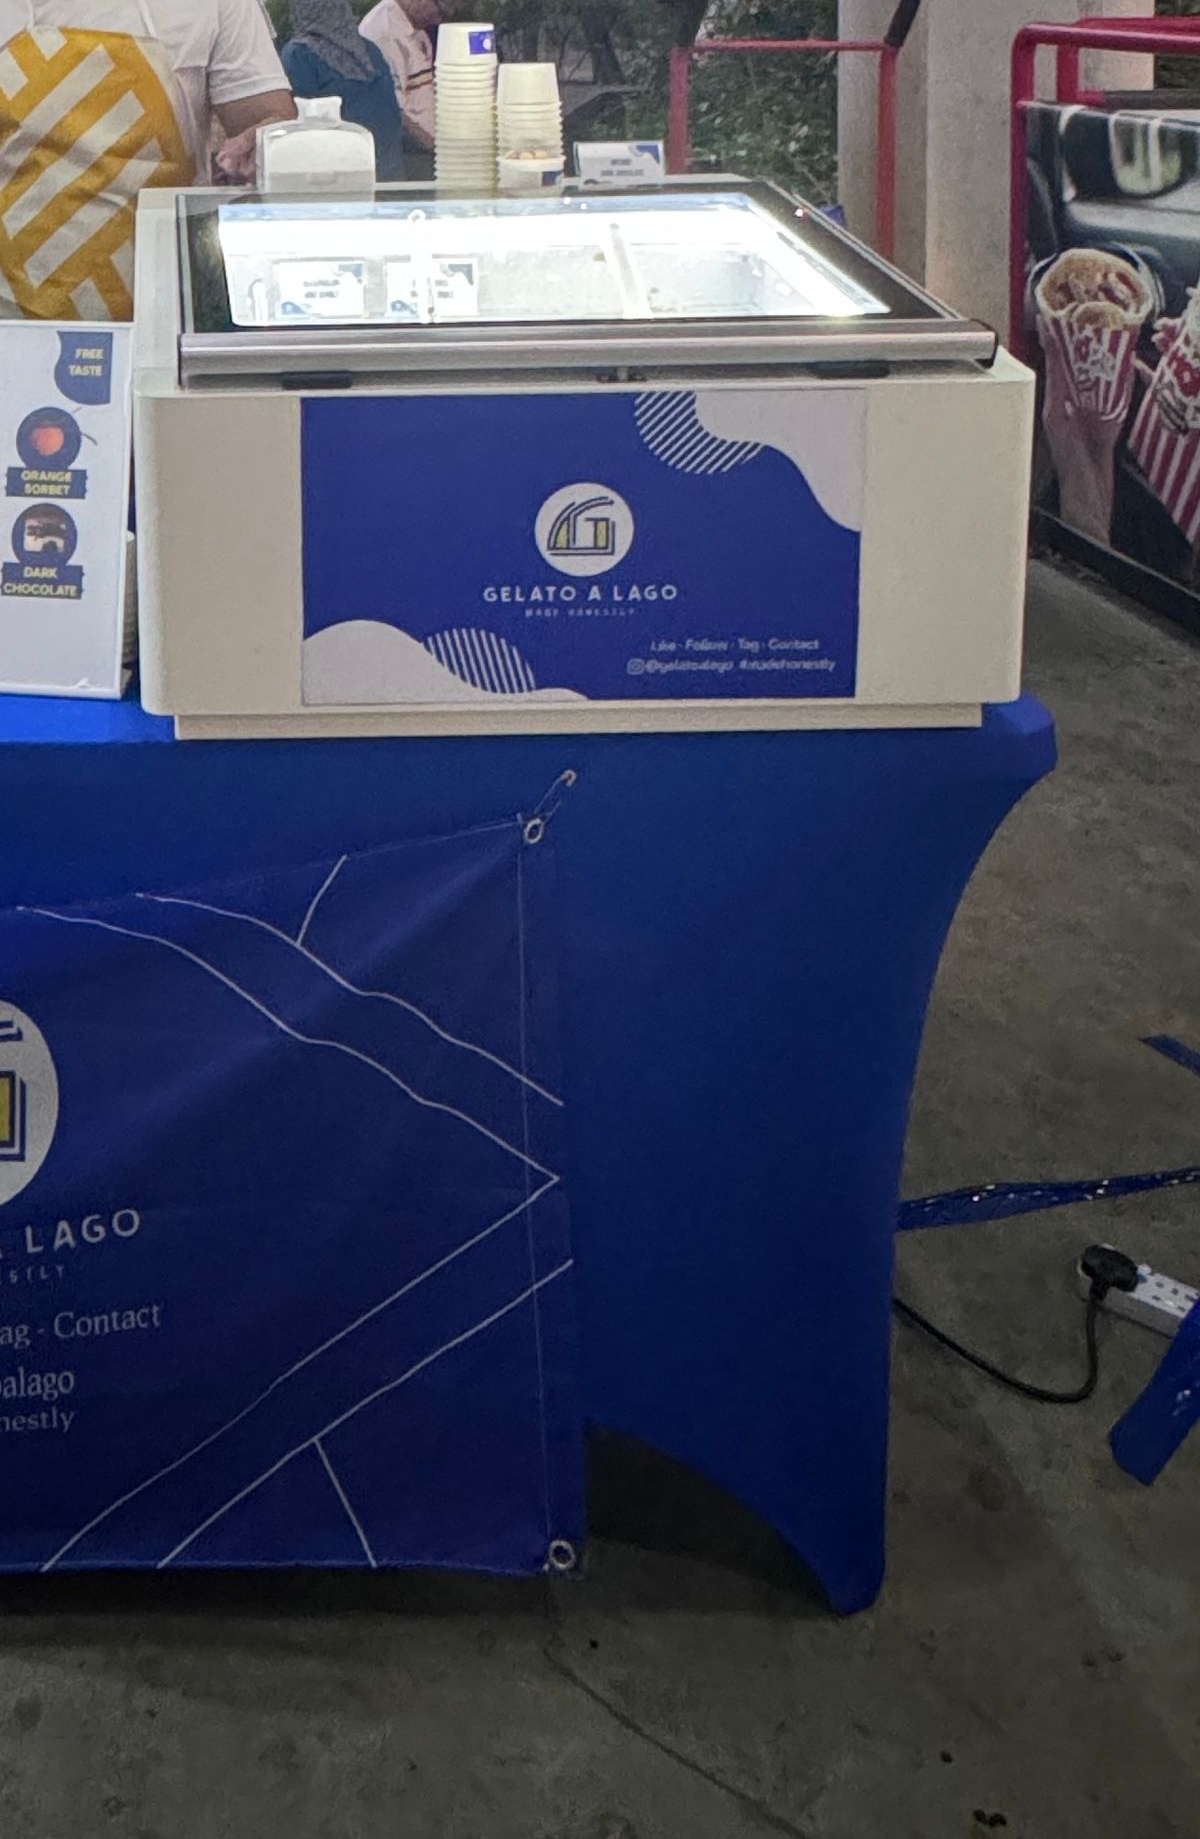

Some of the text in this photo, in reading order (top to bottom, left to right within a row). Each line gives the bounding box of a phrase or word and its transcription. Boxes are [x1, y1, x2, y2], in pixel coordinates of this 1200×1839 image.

[75, 348, 104, 360] FREE
[68, 365, 103, 377] TASTE
[21, 470, 73, 483] ORANGE
[24, 483, 70, 495] SORBET
[23, 567, 59, 579] DARK
[3, 584, 78, 596] CHOCOLATE
[483, 584, 678, 602] GELATO A LAGO
[767, 638, 820, 651] Contact
[26, 1208, 142, 1253] LAGO
[53, 1304, 162, 1340] Contact
